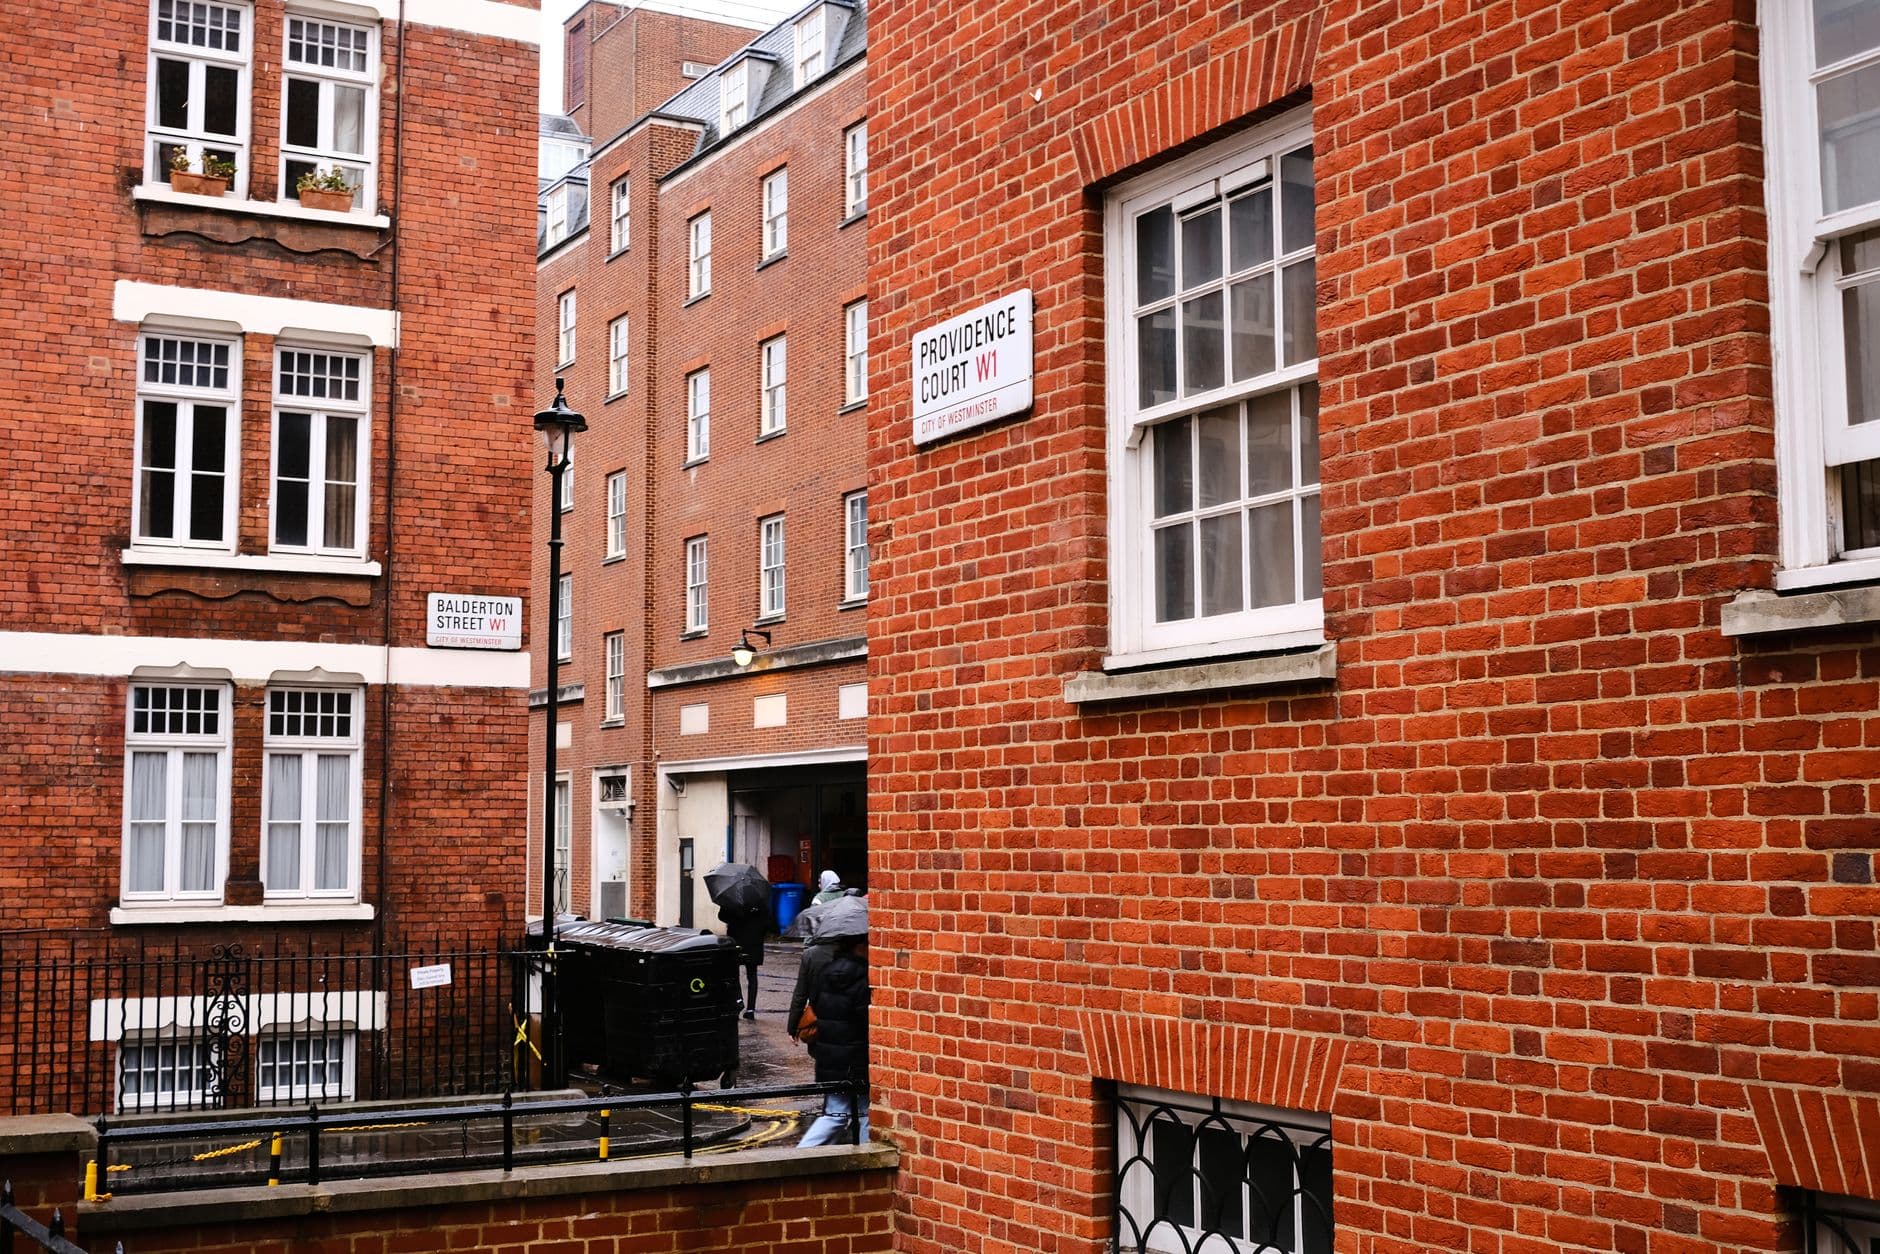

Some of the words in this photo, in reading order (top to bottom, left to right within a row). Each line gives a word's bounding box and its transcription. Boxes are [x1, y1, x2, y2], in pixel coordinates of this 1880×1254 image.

[920, 306, 1016, 369] PROVIDENCE
[921, 360, 968, 404] COURT
[976, 350, 997, 382] W1
[921, 417, 935, 434] CITY
[937, 415, 946, 429] OF
[948, 397, 998, 425] WESTMINSTER
[437, 599, 513, 616] BALDERTON
[437, 615, 484, 630] STREET
[489, 618, 506, 631] W1
[460, 637, 502, 645] WESTMINSTER
